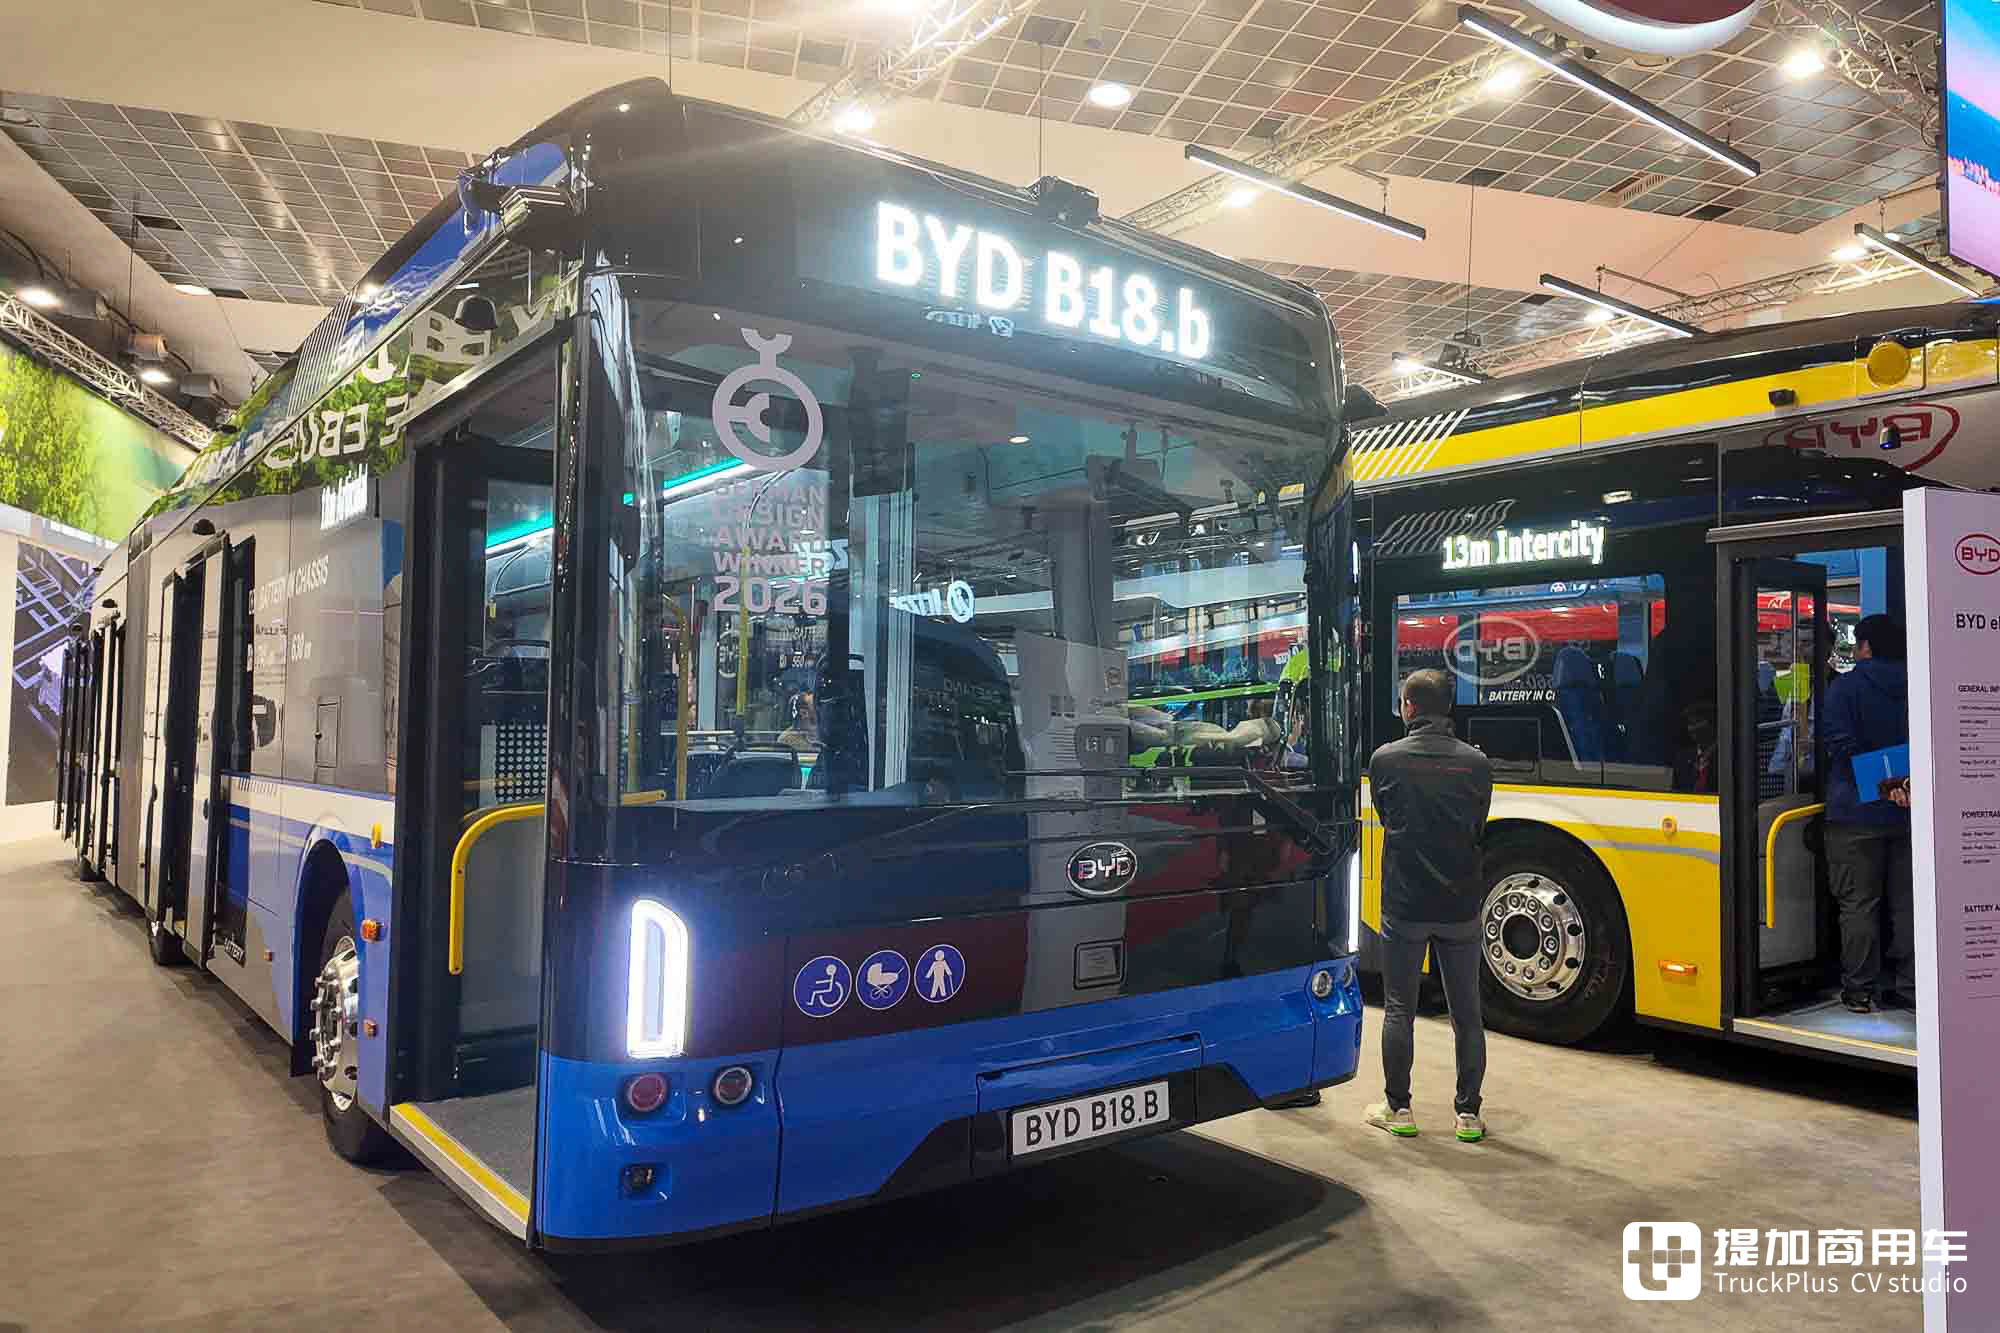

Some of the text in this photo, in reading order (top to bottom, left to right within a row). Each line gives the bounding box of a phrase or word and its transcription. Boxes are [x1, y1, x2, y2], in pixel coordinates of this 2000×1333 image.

[875, 200, 1211, 360] BYD B18.b
[1443, 520, 1605, 569] 13m Intercity
[1961, 547, 2000, 562] BYD
[712, 576, 828, 616] 2026
[1956, 613, 2000, 629] BYD e
[1488, 690, 1532, 702] BATTERY
[1533, 690, 1544, 700] IN
[1078, 856, 1132, 880] BYD
[1026, 1089, 1159, 1146] BYD B18.B
